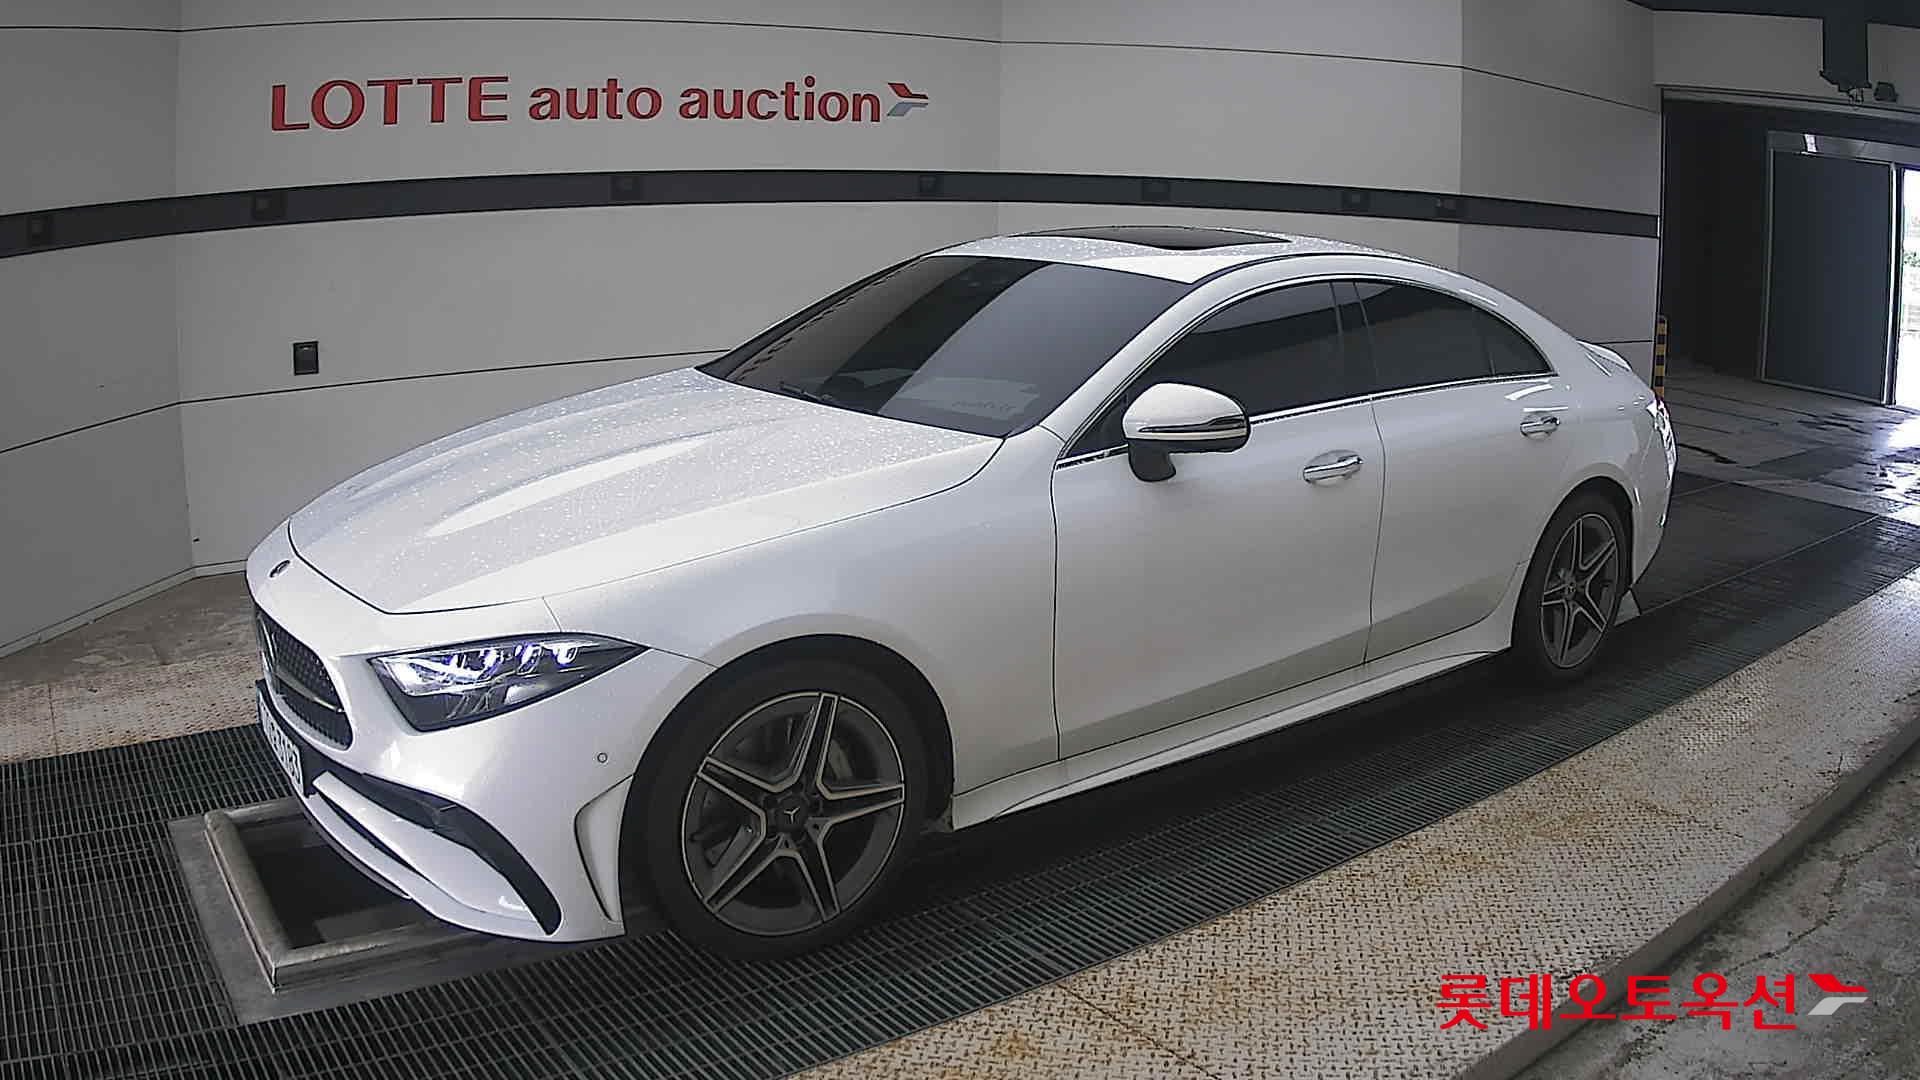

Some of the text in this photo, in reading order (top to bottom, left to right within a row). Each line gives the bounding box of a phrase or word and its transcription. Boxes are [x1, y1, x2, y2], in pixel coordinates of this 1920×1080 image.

[271, 76, 881, 131] LOTTE auto auction
